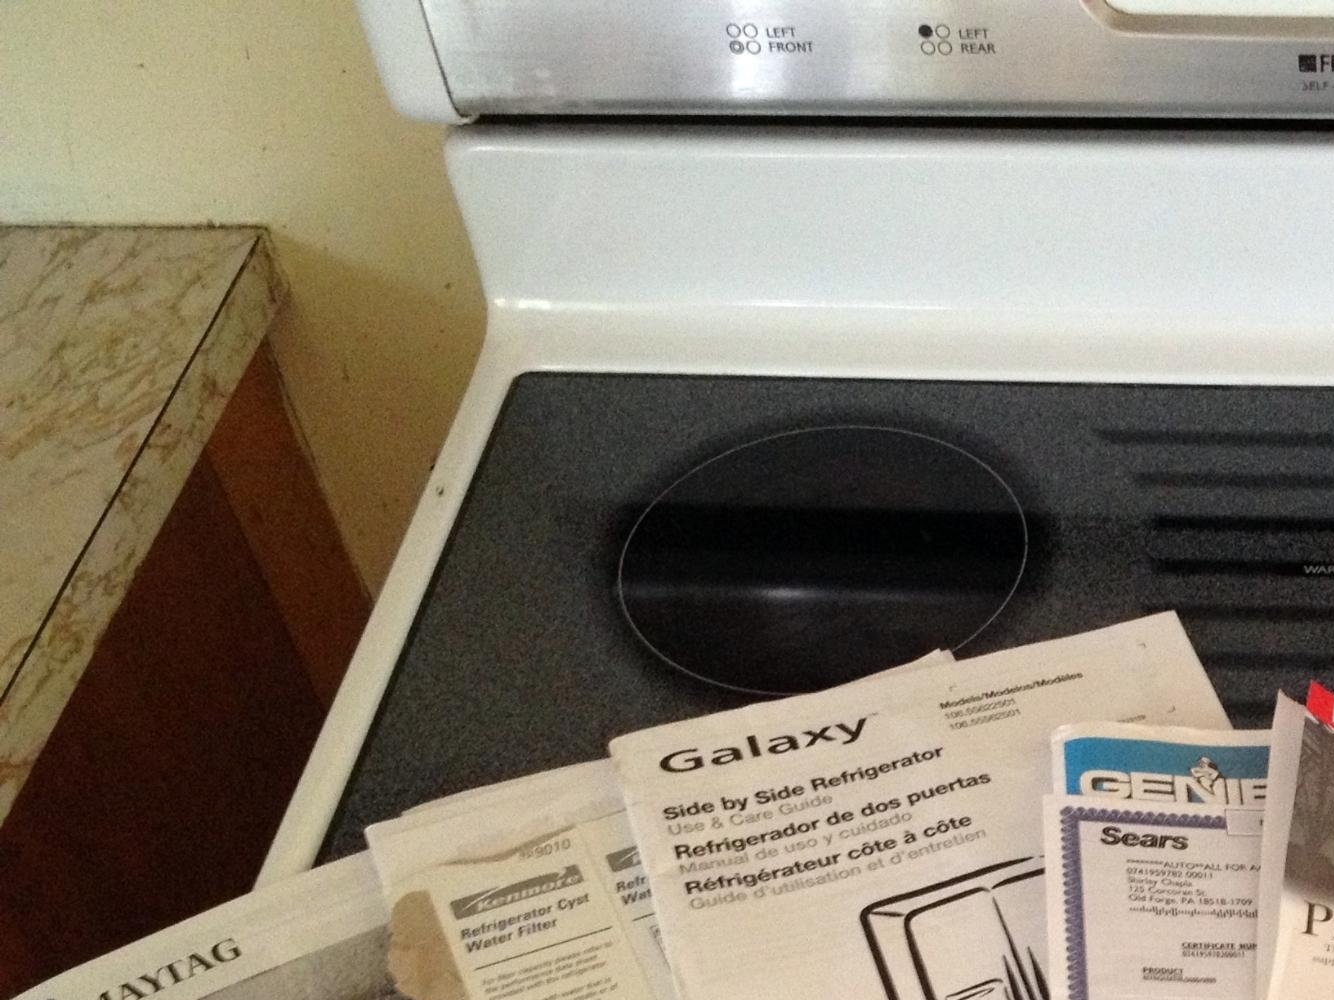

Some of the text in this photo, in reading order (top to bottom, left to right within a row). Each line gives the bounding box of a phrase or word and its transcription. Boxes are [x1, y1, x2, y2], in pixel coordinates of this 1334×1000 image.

[766, 27, 795, 38] LEFT
[769, 41, 813, 53] FRONT
[959, 29, 989, 39] LEFT
[961, 43, 996, 54] REAR
[659, 714, 868, 773] Galaxy
[664, 745, 943, 821] Side by Side Refrigerator
[668, 794, 833, 836] Use & Care Guide
[675, 771, 991, 860] Refrigerador de dos puertas
[680, 810, 912, 875] Manual de uso y cuidado
[685, 814, 972, 896] Réfrigérateur côte à côte
[1101, 825, 1189, 851] Sears
[690, 827, 986, 911] Guide d'utilisation et d'entretien
[461, 893, 590, 941] Refrigerator Cyst
[466, 918, 557, 953] Water Filter
[1182, 942, 1235, 950] CERTIFICATE
[1143, 967, 1183, 975] PRODUCT
